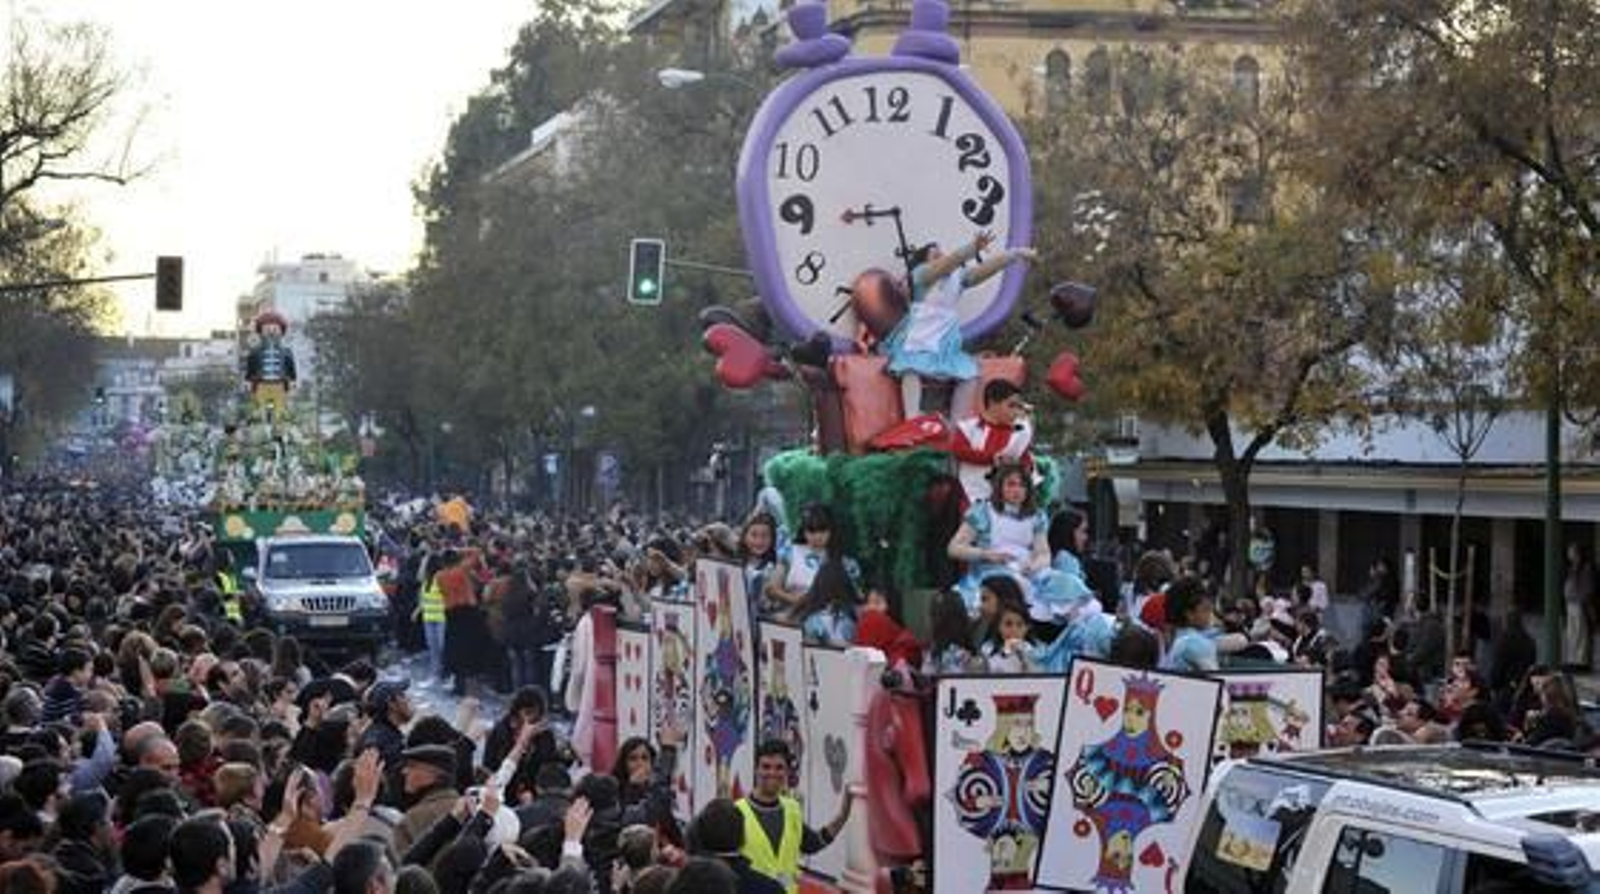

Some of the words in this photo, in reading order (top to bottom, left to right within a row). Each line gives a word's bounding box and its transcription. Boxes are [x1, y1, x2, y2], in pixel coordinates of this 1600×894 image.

[812, 95, 855, 137] 11
[863, 86, 911, 123] 12
[928, 93, 955, 140] 1
[775, 141, 820, 182] 10
[955, 132, 992, 172] 2
[779, 192, 815, 236] 9
[962, 174, 1005, 227] 3
[795, 250, 826, 286] 8
[943, 687, 957, 719] J
[1075, 667, 1095, 704] Q
